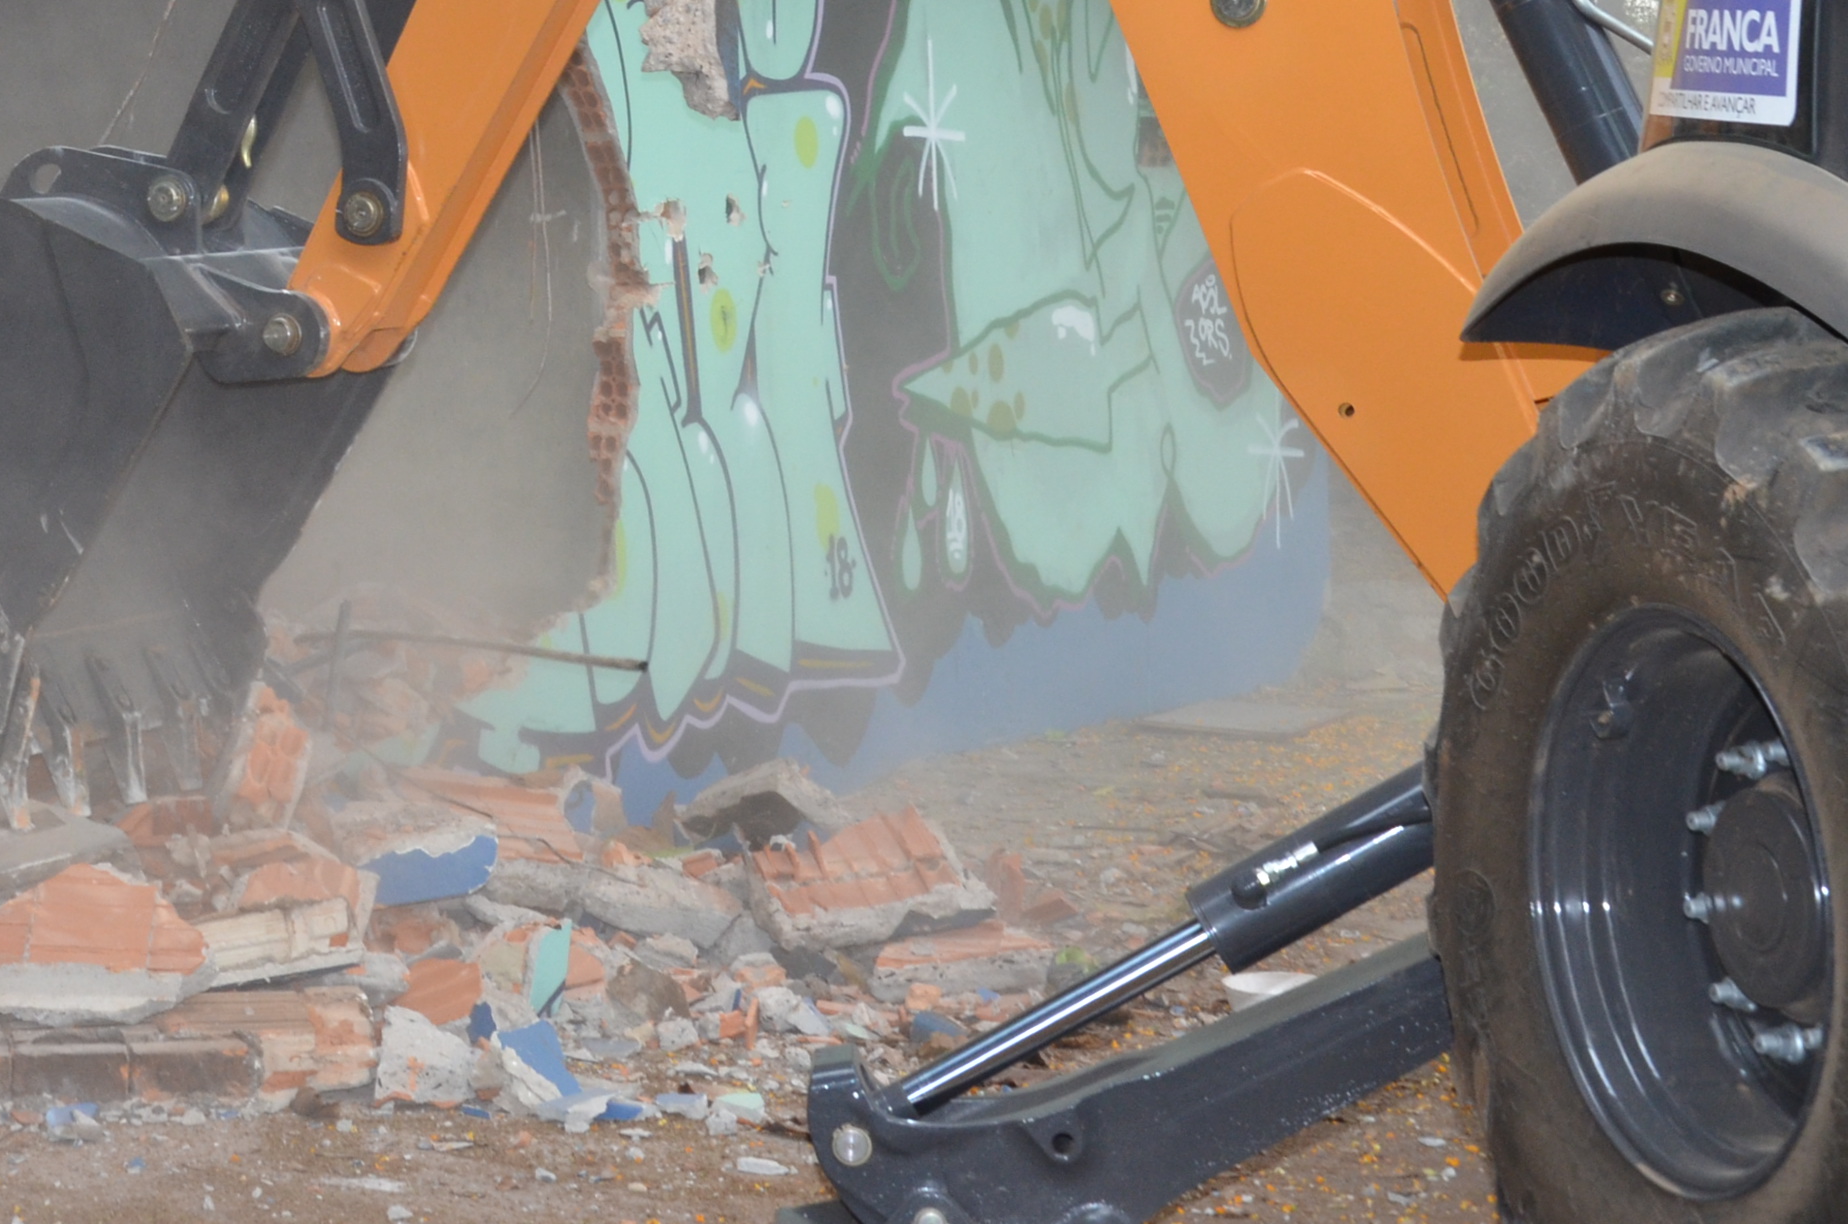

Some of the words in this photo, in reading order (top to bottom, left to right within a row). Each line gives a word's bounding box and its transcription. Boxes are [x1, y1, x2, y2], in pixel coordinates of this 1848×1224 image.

[1685, 8, 1780, 53] FRANCA
[1683, 55, 1722, 74] GOVERNO
[1723, 57, 1779, 77] MUNICIPAL
